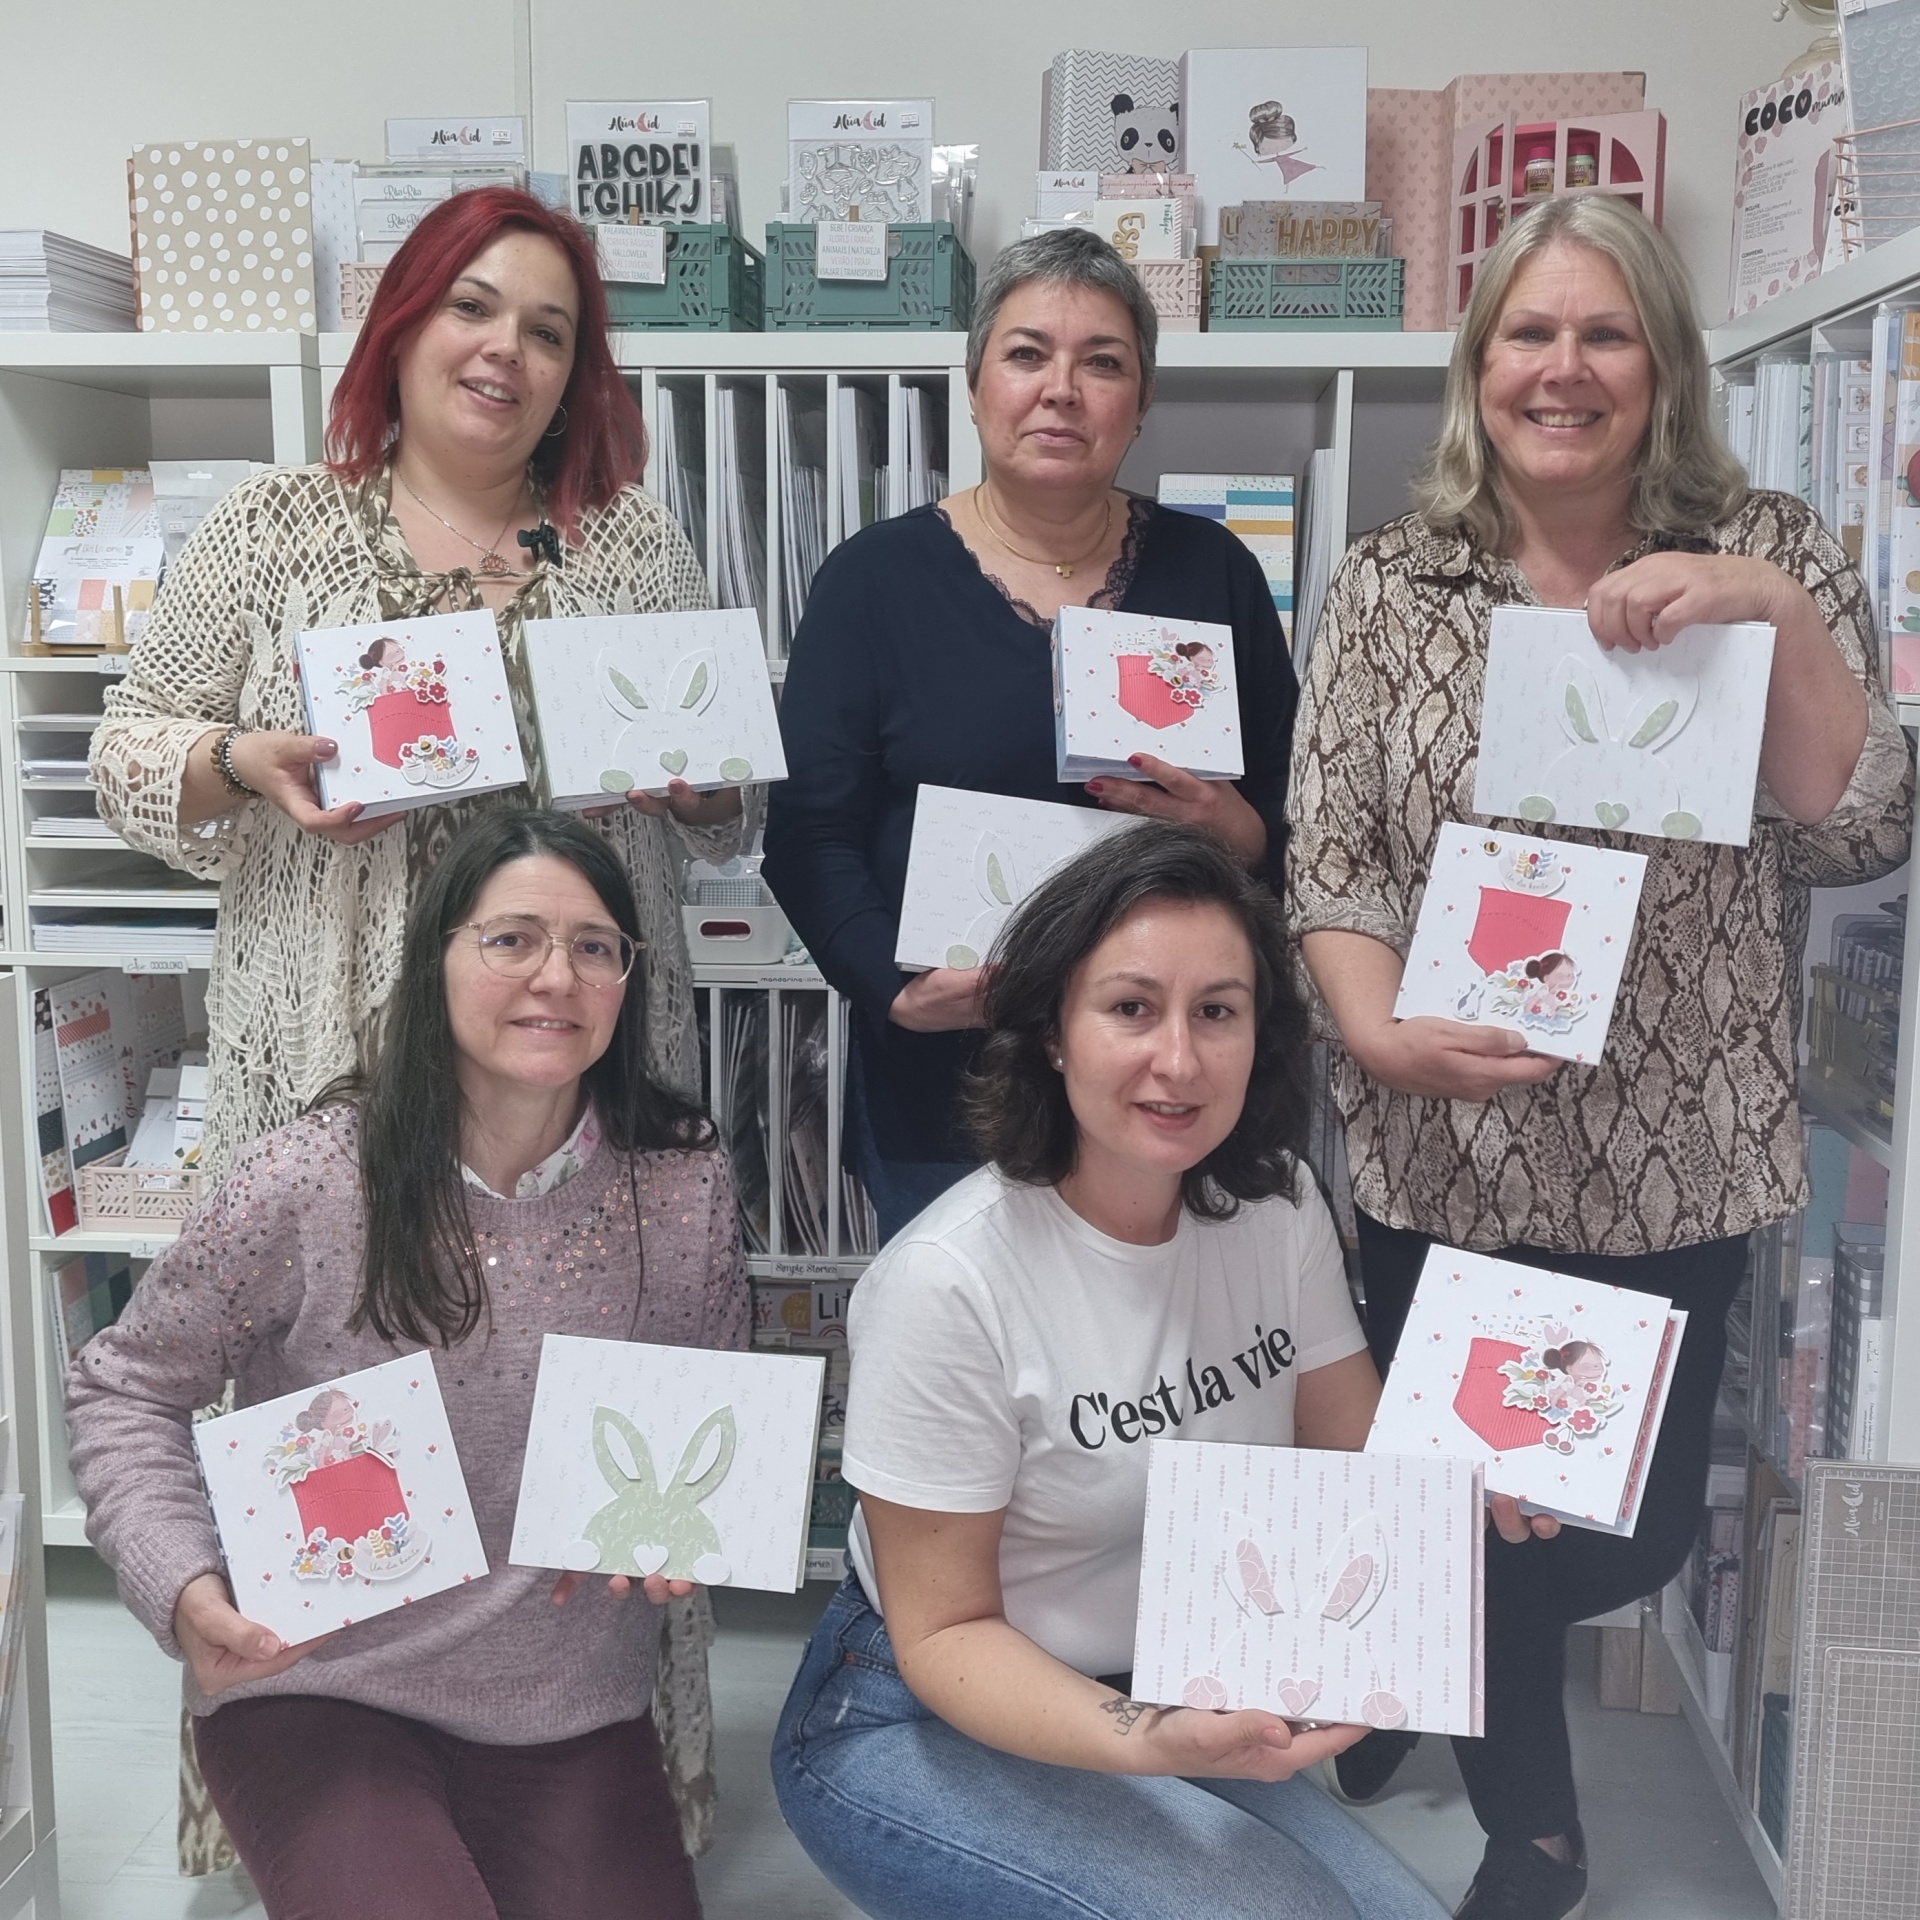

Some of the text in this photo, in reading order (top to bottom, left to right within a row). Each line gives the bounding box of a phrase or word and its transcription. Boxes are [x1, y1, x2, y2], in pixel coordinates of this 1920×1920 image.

[1745, 89, 1812, 136] COCO
[1277, 217, 1380, 251] HAPPY
[612, 248, 648, 258] HALLOWEEN
[851, 246, 881, 255] NATUREZA
[843, 268, 884, 278] TRANSPORTES
[775, 1262, 838, 1276] Simple Stories
[1069, 1323, 1297, 1450] C'est la vie
